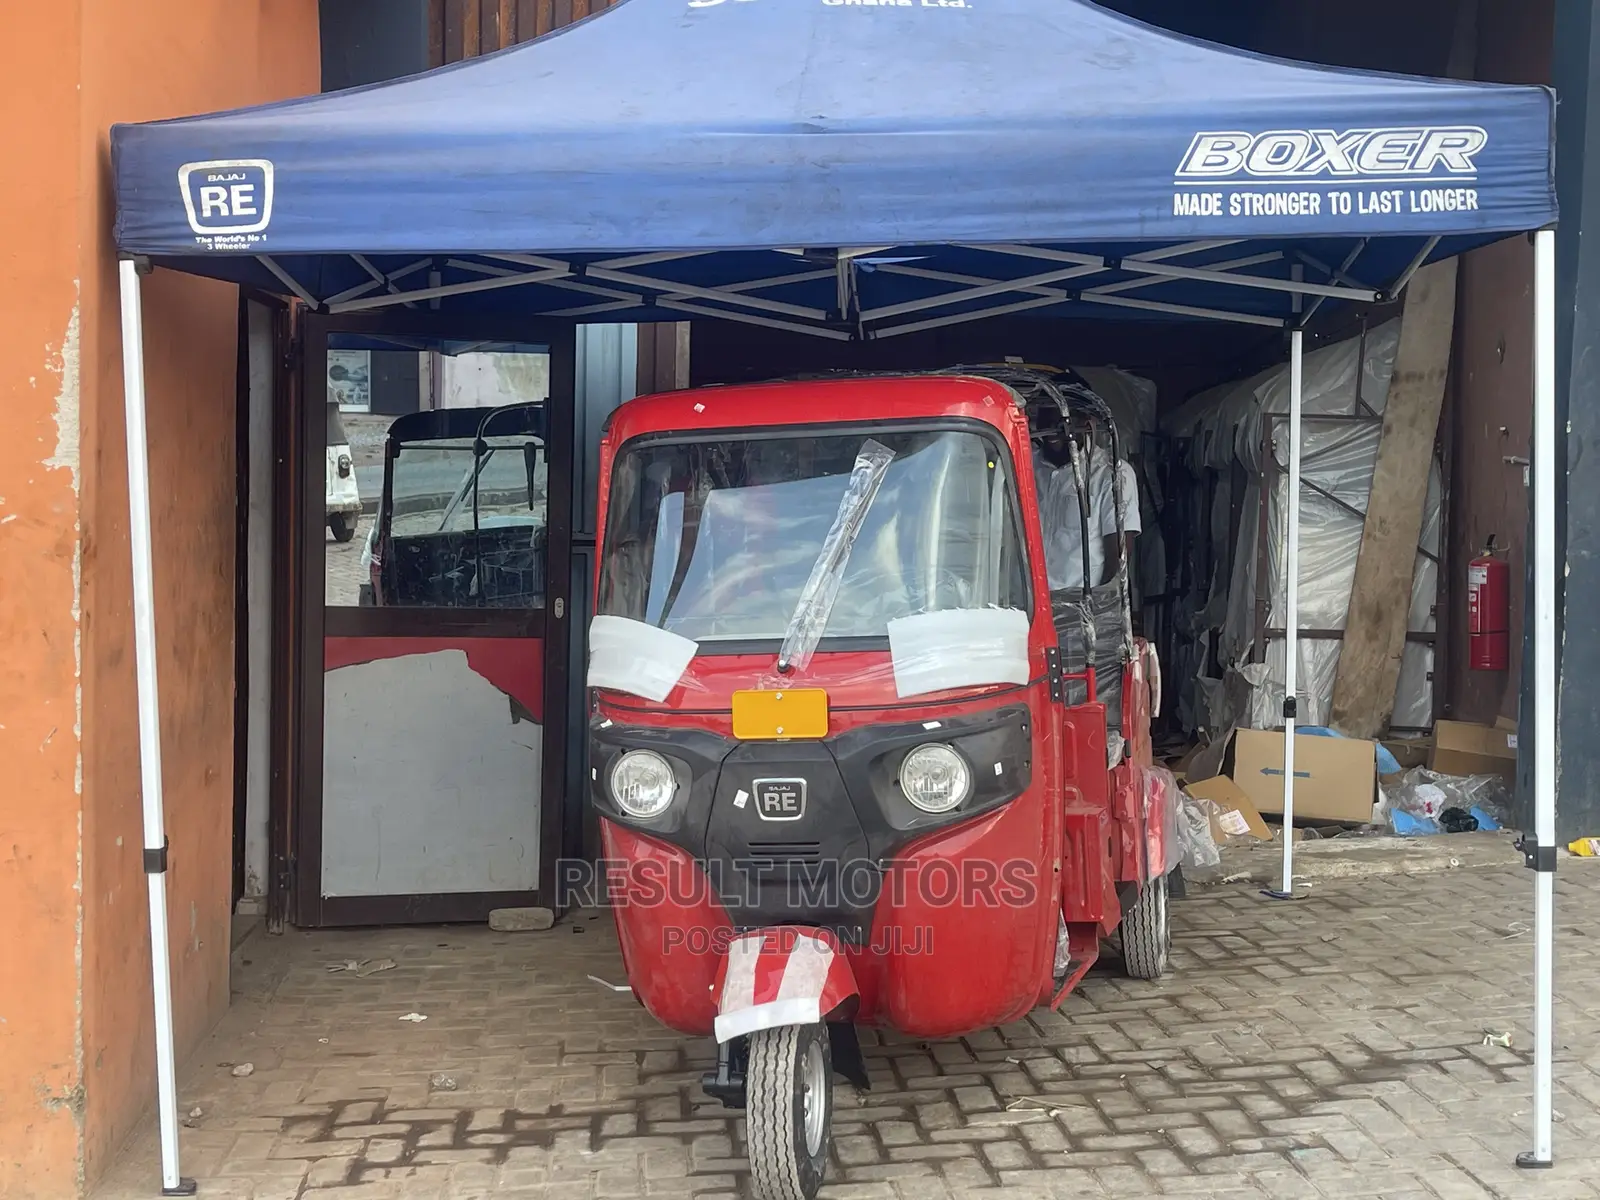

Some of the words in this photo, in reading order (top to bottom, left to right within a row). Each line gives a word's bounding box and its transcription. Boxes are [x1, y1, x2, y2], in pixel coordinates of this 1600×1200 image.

[1174, 125, 1488, 177] BOXER
[207, 173, 246, 182] BAJAJ
[200, 184, 257, 217] RE
[1173, 192, 1224, 216] MADE
[1229, 191, 1321, 216] STRONGER
[1327, 191, 1352, 215] TO
[1358, 189, 1404, 213] LAST
[1410, 188, 1479, 213] LONGER
[195, 236, 213, 244] The
[213, 234, 246, 243] World's
[247, 233, 260, 242] No
[261, 233, 267, 242] 1
[206, 243, 213, 251] 3
[214, 242, 251, 251] Wheeler
[763, 792, 798, 812] RE
